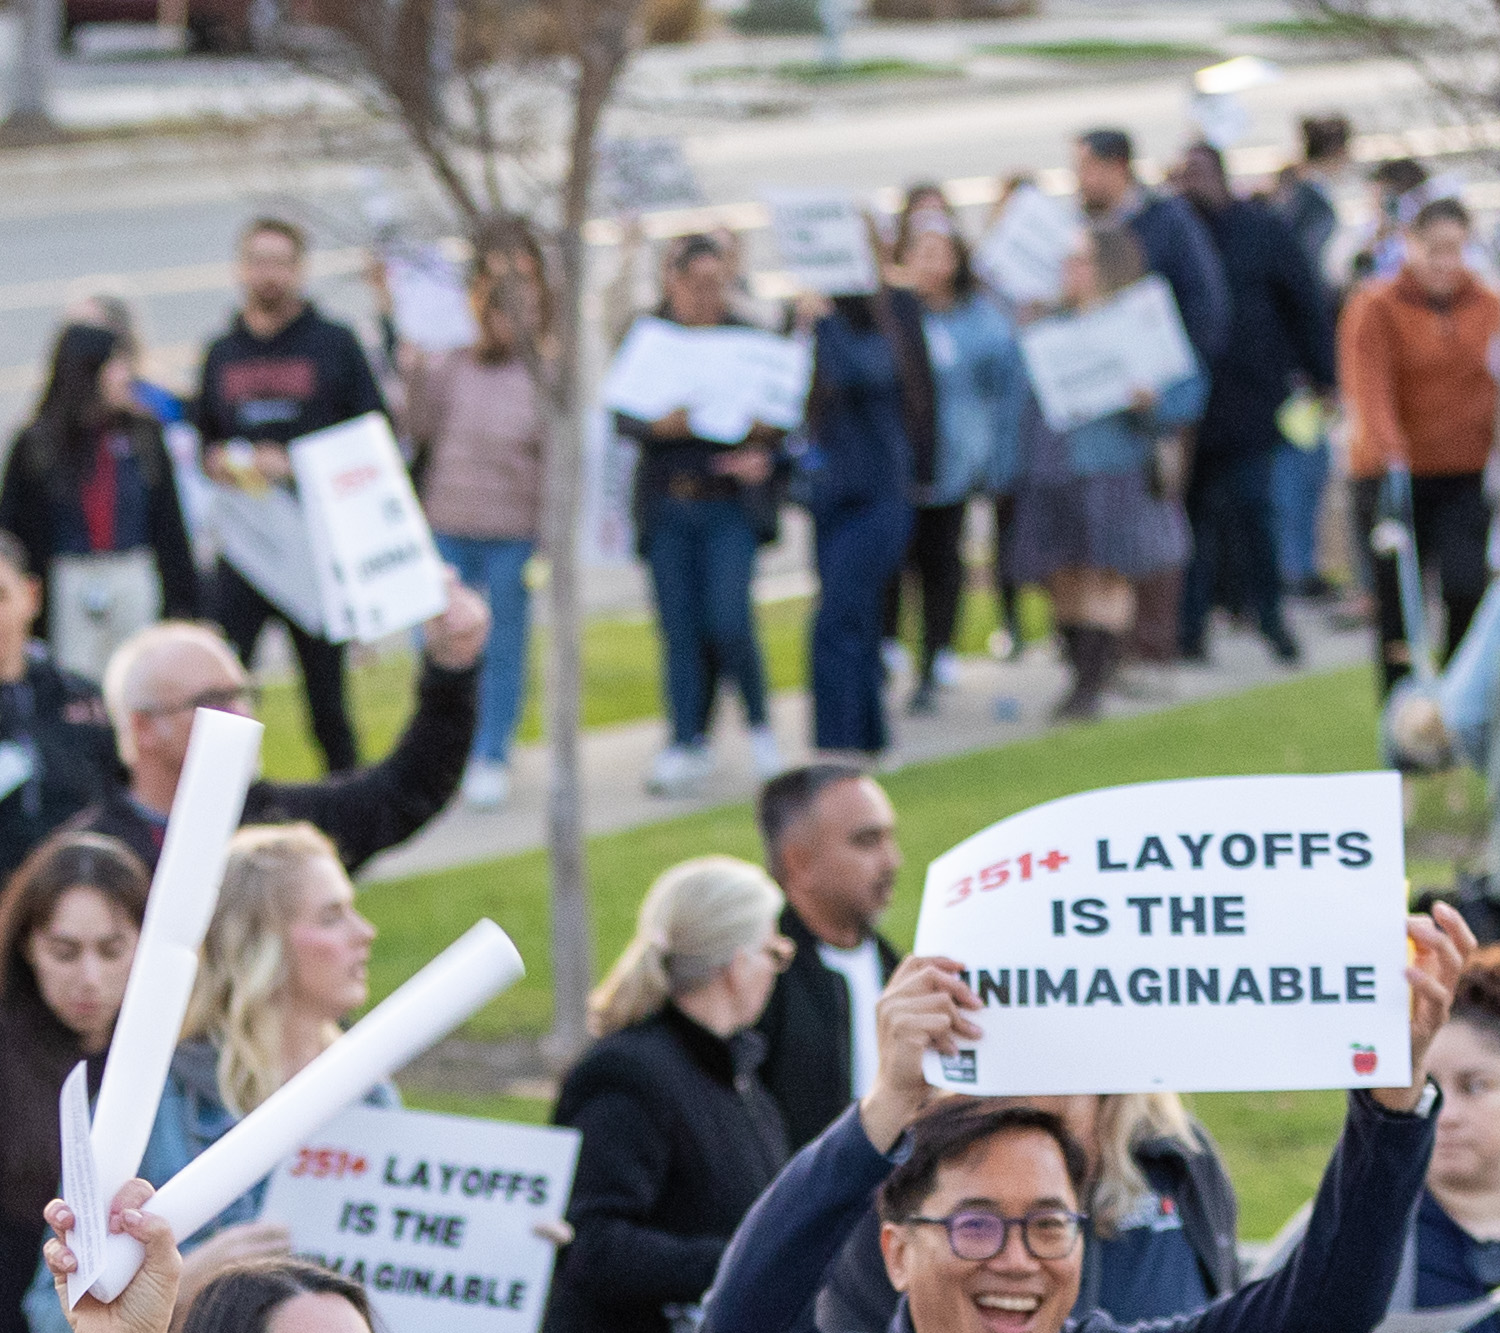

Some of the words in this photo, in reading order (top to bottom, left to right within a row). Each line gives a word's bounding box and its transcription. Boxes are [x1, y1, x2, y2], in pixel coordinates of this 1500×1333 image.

[945, 848, 1070, 908] 351+
[1097, 831, 1373, 873] LAYOFFS
[1052, 898, 1110, 936] IS
[1127, 896, 1246, 935] THE
[291, 1148, 367, 1178] 351+
[383, 1155, 549, 1204] LAYOFFS
[339, 1201, 378, 1234] IS
[392, 1208, 466, 1248] THE
